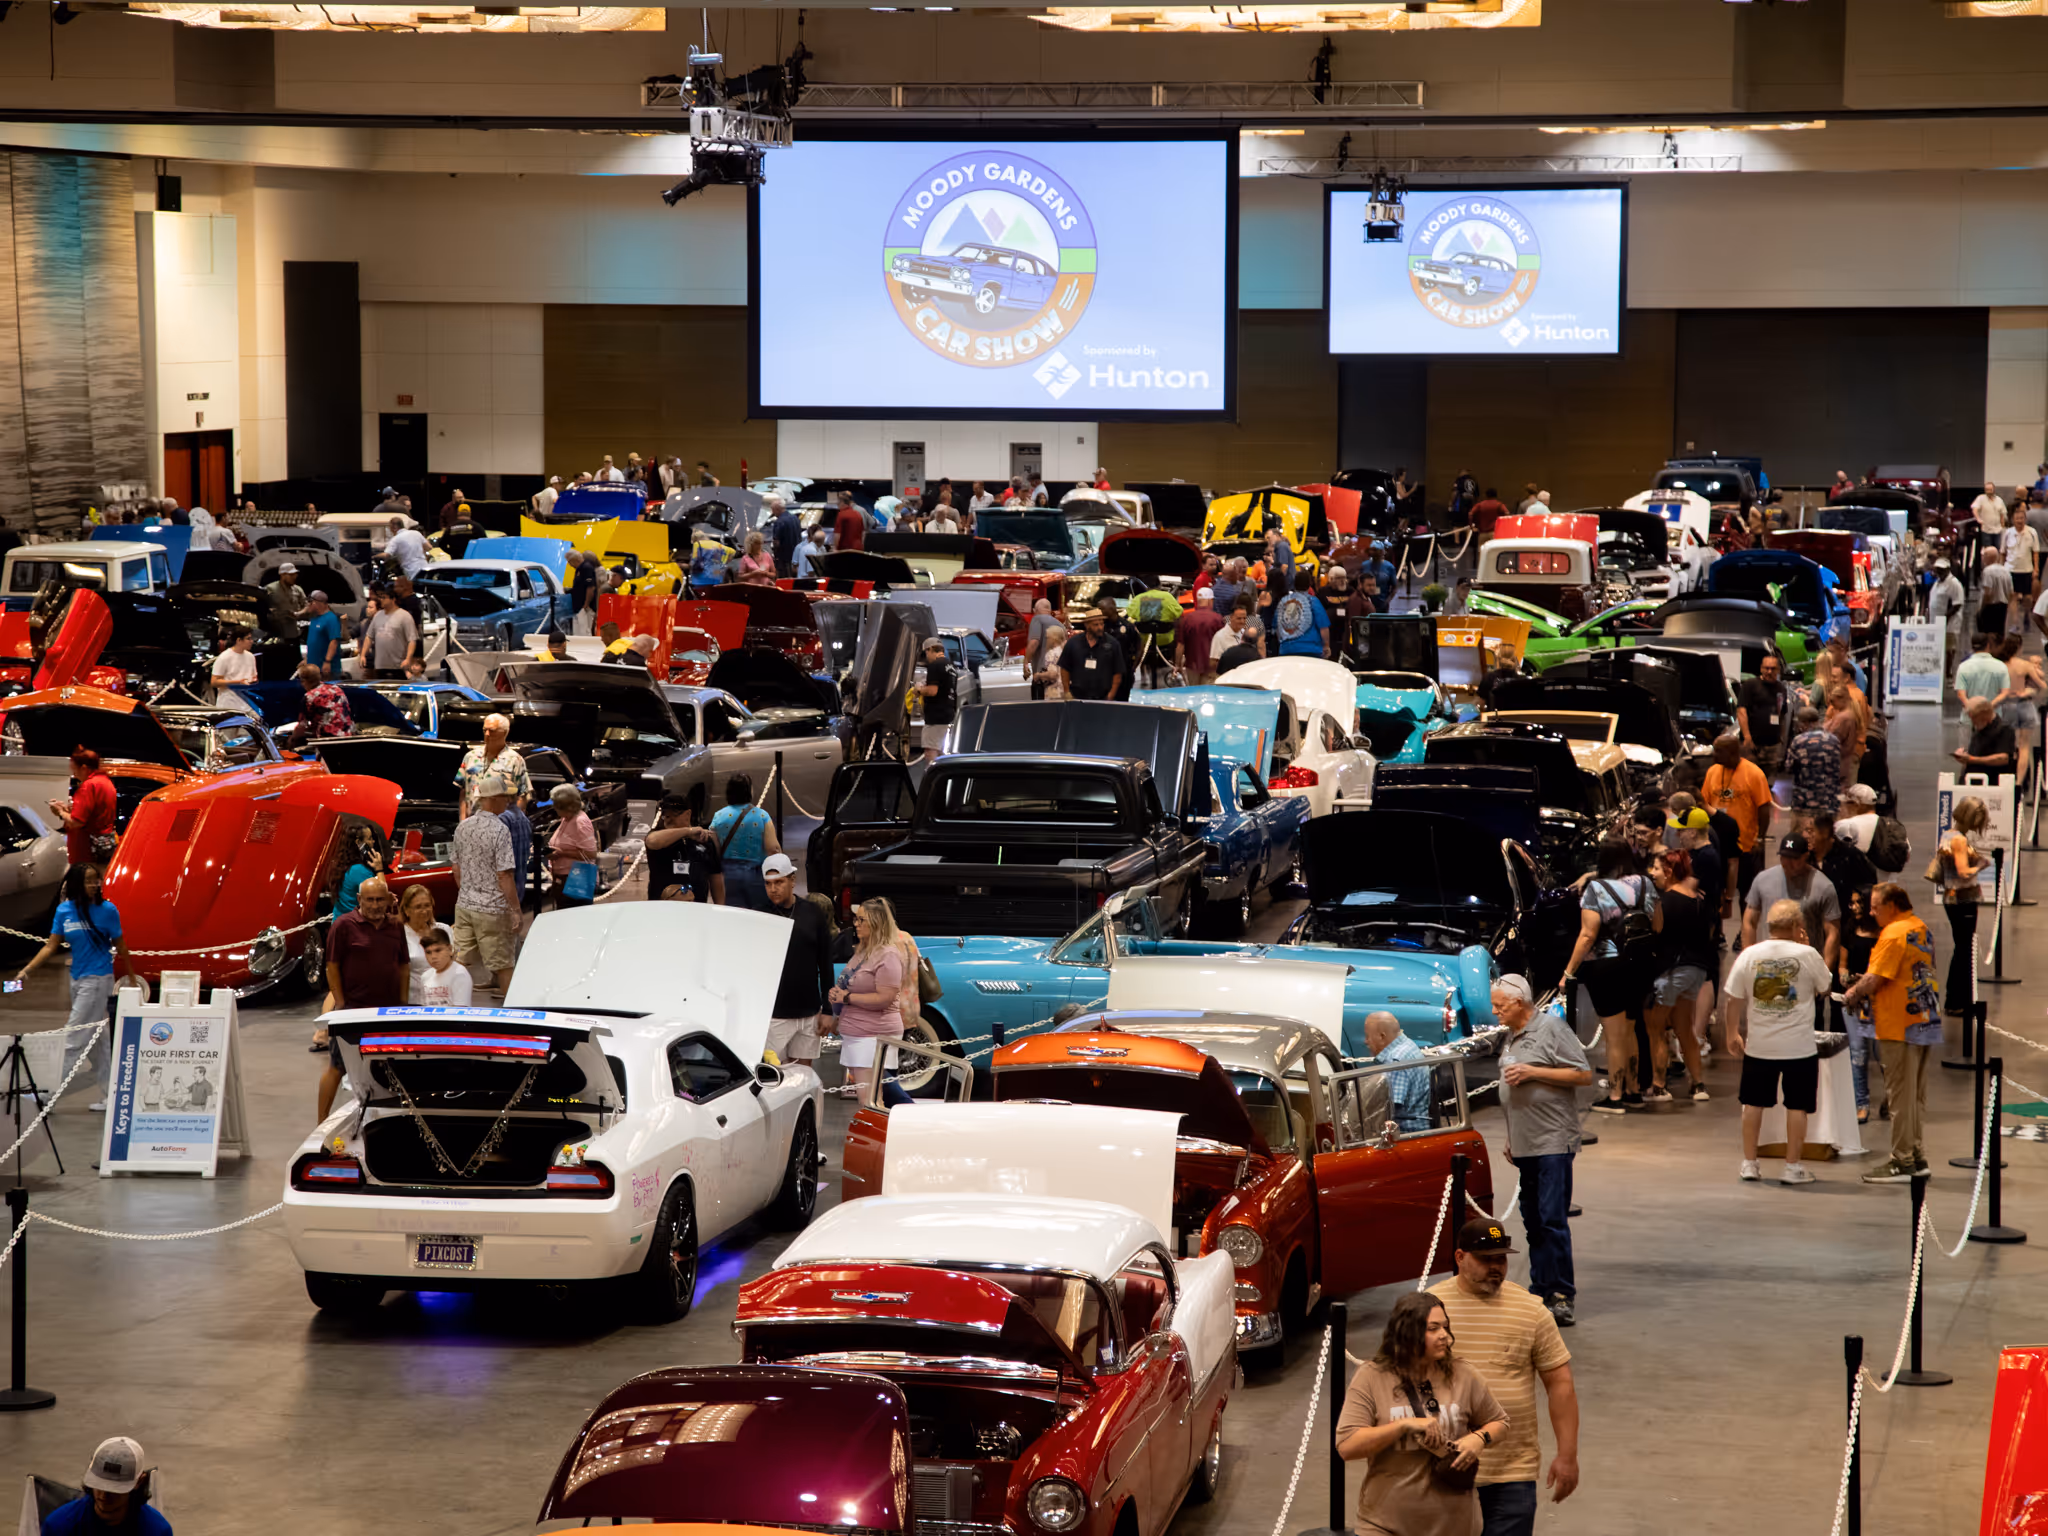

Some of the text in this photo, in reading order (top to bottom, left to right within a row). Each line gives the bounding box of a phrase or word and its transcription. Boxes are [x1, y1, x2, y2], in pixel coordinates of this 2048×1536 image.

[902, 162, 1078, 230] MOODY GARDENS
[1420, 203, 1530, 245] MOODY GARDENS
[1427, 291, 1520, 325] CAR SHOW
[915, 307, 1065, 362] CAR SHOW
[1534, 324, 1610, 341] Hunton
[1083, 344, 1158, 358] Sponsored by
[1088, 364, 1210, 389] Hunton
[385, 1007, 536, 1018] CHALLENGE HER
[140, 1050, 219, 1059] YOUR FIRST CAR
[115, 1044, 135, 1135] Keys to Freedom
[424, 1245, 469, 1262] PIXCDST
